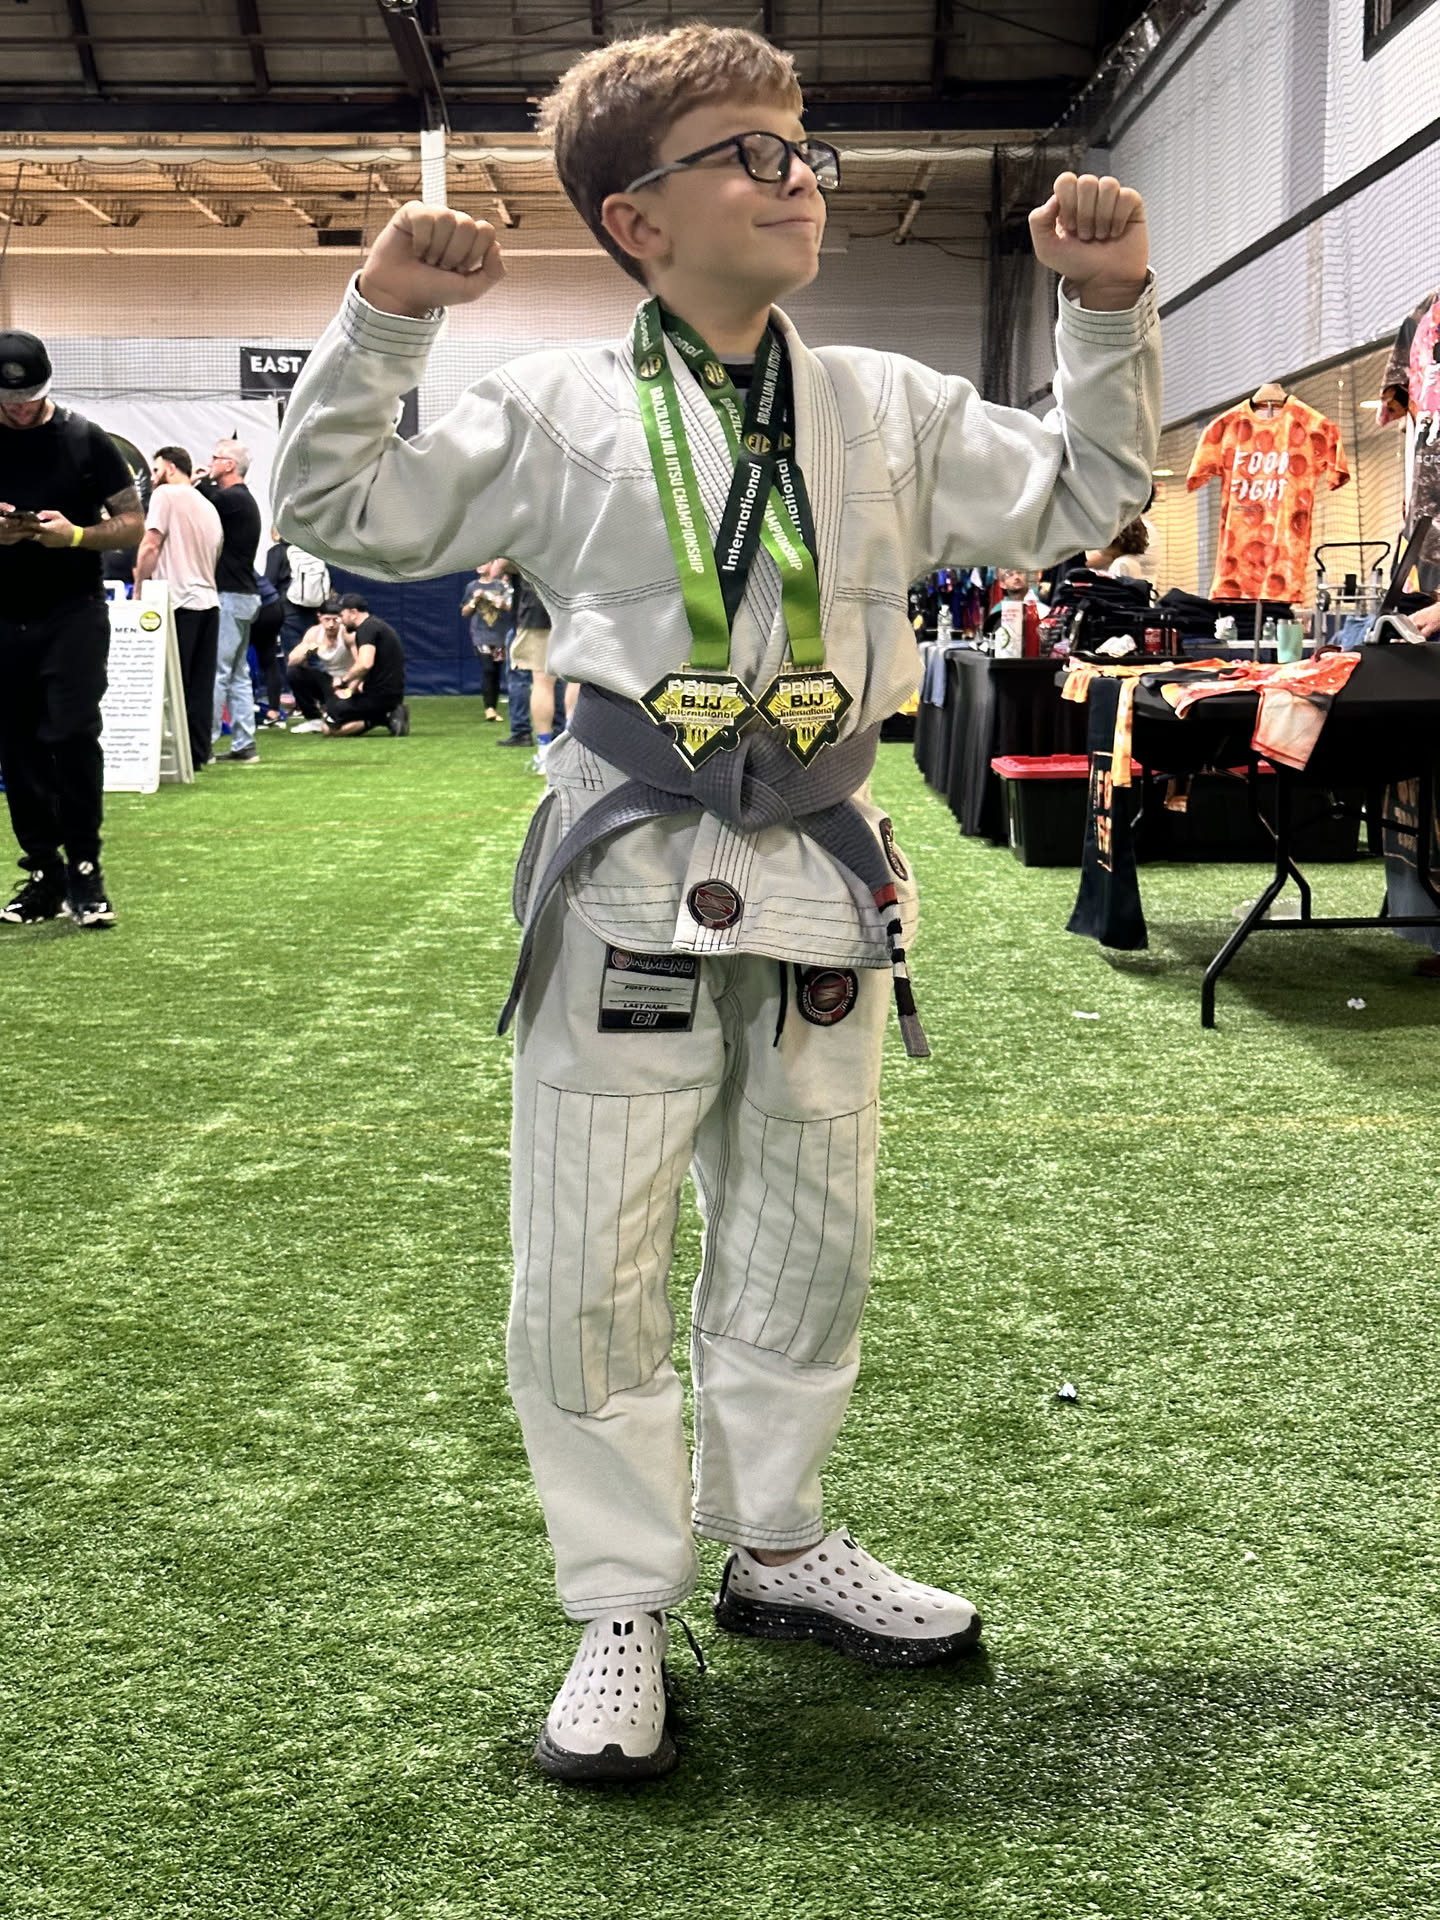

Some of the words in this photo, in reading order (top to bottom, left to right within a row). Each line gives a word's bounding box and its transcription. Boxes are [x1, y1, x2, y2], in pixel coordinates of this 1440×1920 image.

[249, 355, 303, 374] EAST
[649, 385, 674, 439] BRAZILIAN
[660, 439, 679, 456] JIU
[664, 457, 686, 487] JITSU
[1230, 478, 1288, 502] FIGHT
[721, 462, 763, 572] International
[672, 487, 705, 574] CHAMPIONSHIP
[668, 679, 739, 697] PRIDE
[778, 678, 834, 696] PRIDE
[681, 694, 722, 710] BJJ
[790, 693, 824, 708] BJJ
